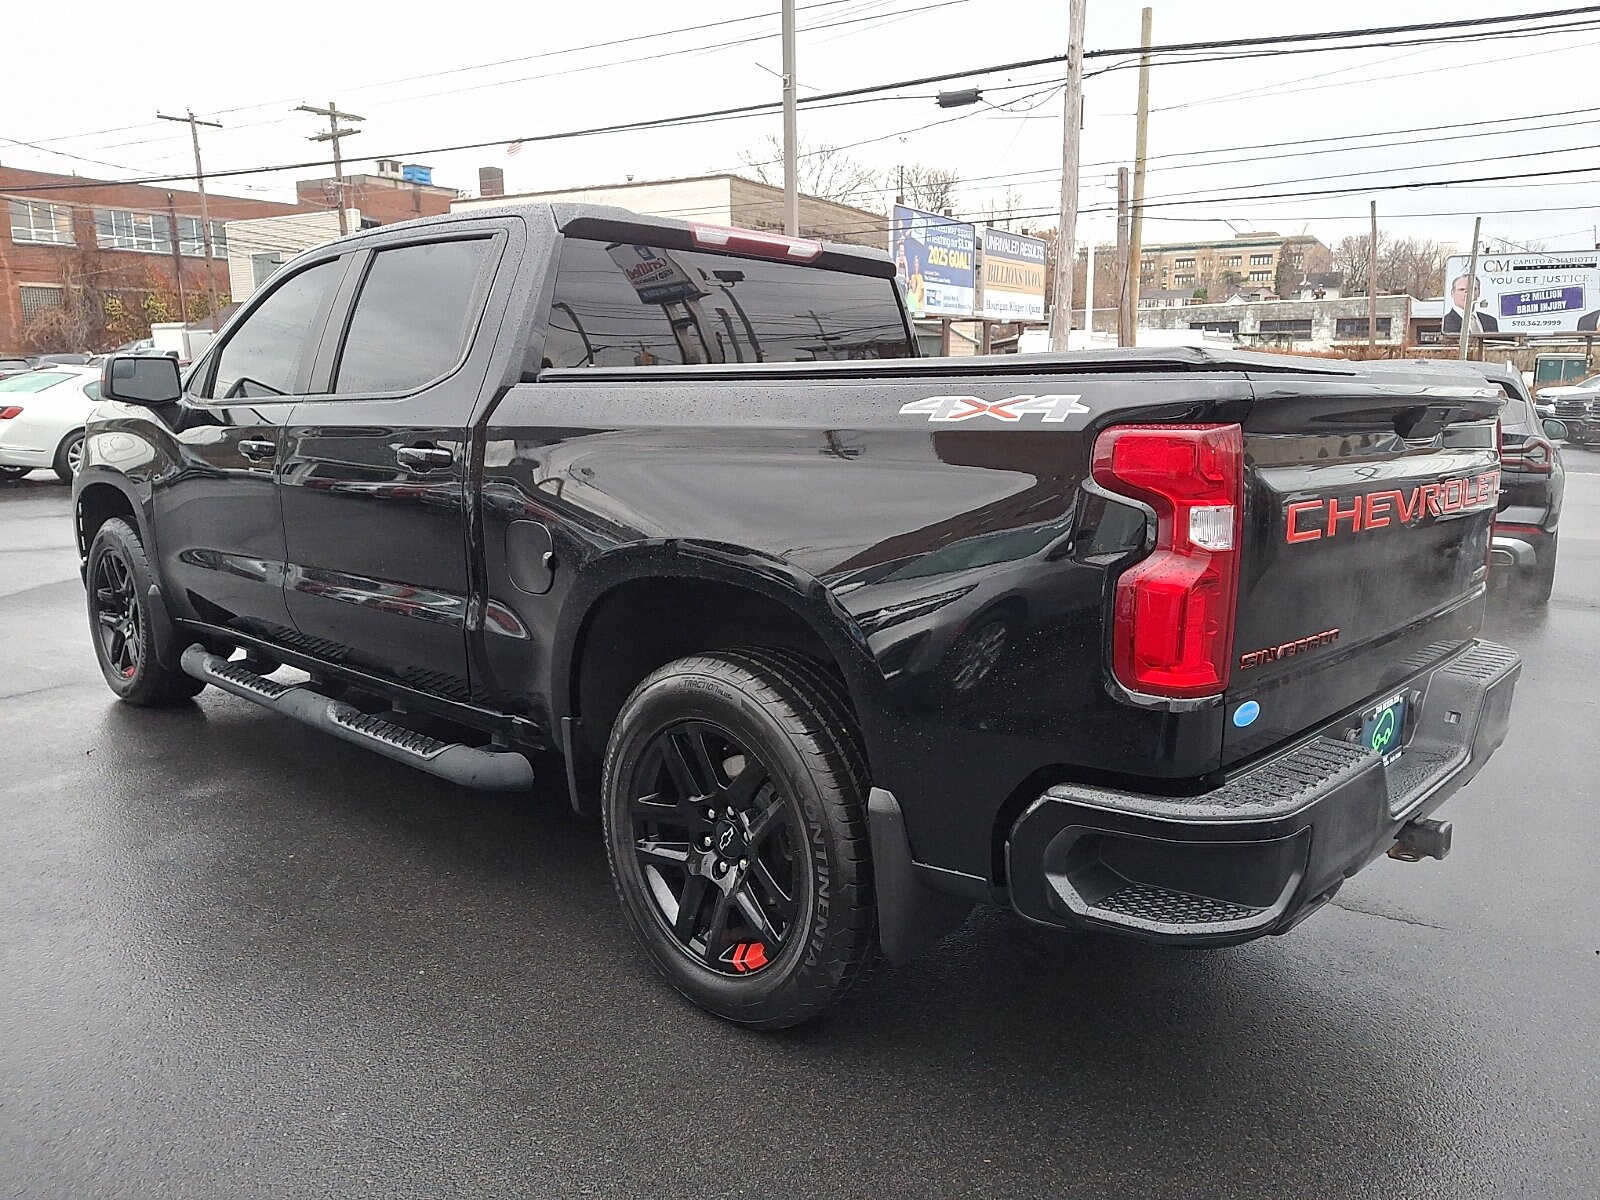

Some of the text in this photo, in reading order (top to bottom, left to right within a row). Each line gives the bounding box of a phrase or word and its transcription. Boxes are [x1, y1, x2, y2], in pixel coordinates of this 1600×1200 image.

[986, 234, 1019, 255] UNRIVALED
[928, 245, 971, 271] 2025 GOAL!
[1483, 259, 1510, 273] CM
[1556, 255, 1598, 264] MARIOTTI
[987, 264, 1023, 286] BILLIONS
[1490, 277, 1512, 285] YOU
[1517, 276, 1539, 284] GET
[1520, 290, 1563, 302] $2 MILLION
[1516, 300, 1567, 314] BRAIN INJURY
[1286, 471, 1501, 544] CHEVROLET
